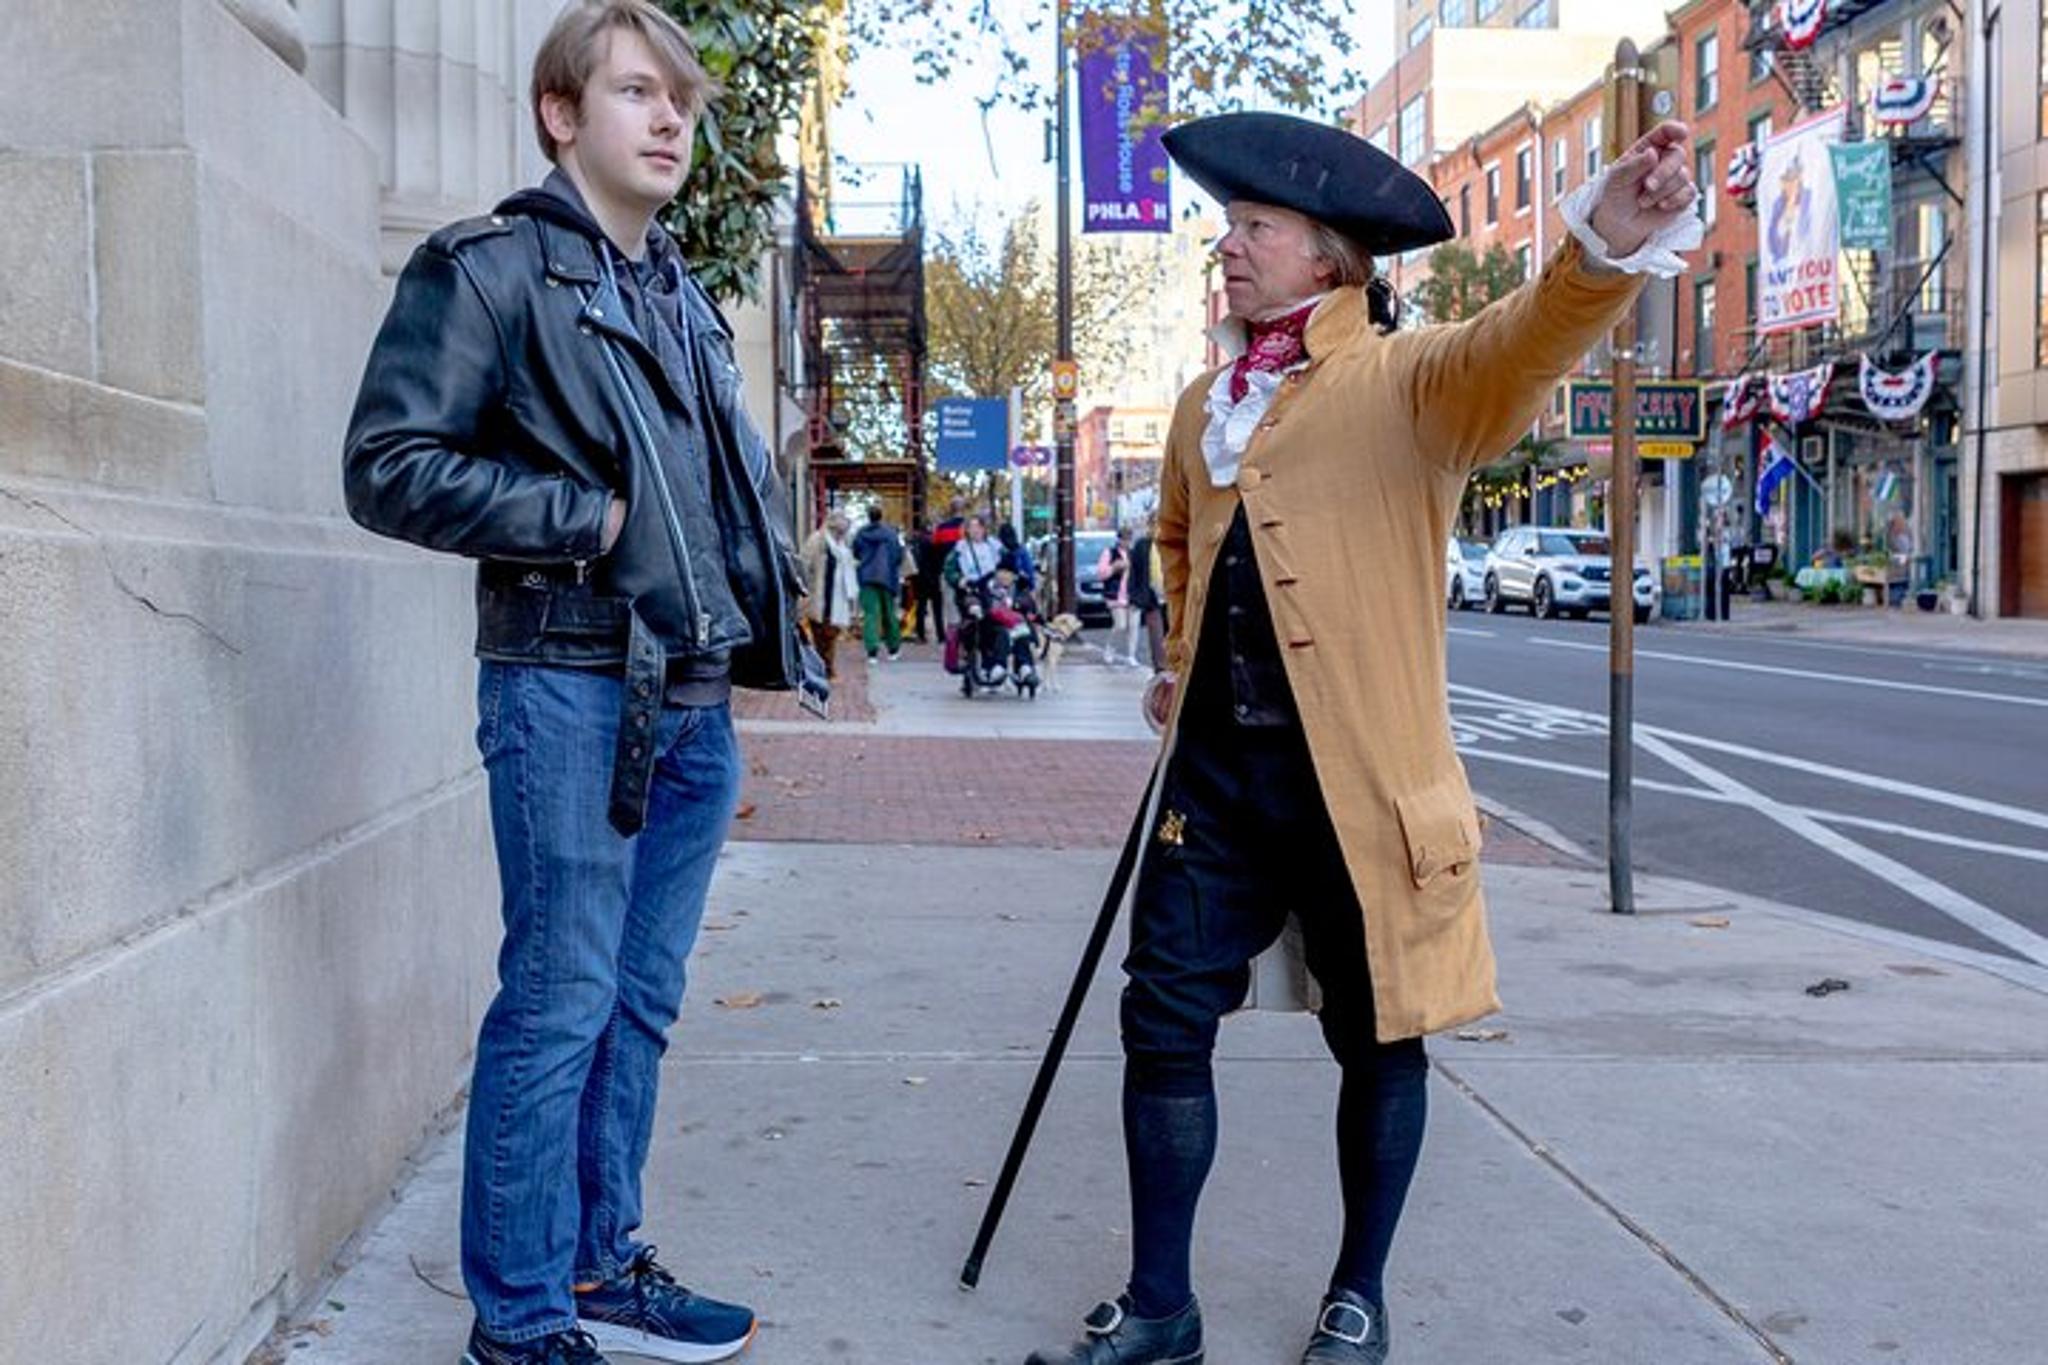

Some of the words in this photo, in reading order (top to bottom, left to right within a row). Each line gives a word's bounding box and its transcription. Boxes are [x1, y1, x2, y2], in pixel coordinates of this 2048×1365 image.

[1117, 133, 1133, 193] House
[1088, 198, 1167, 224] PHLASH
[1797, 258, 1833, 281] YOU
[1783, 283, 1832, 314] VOTE
